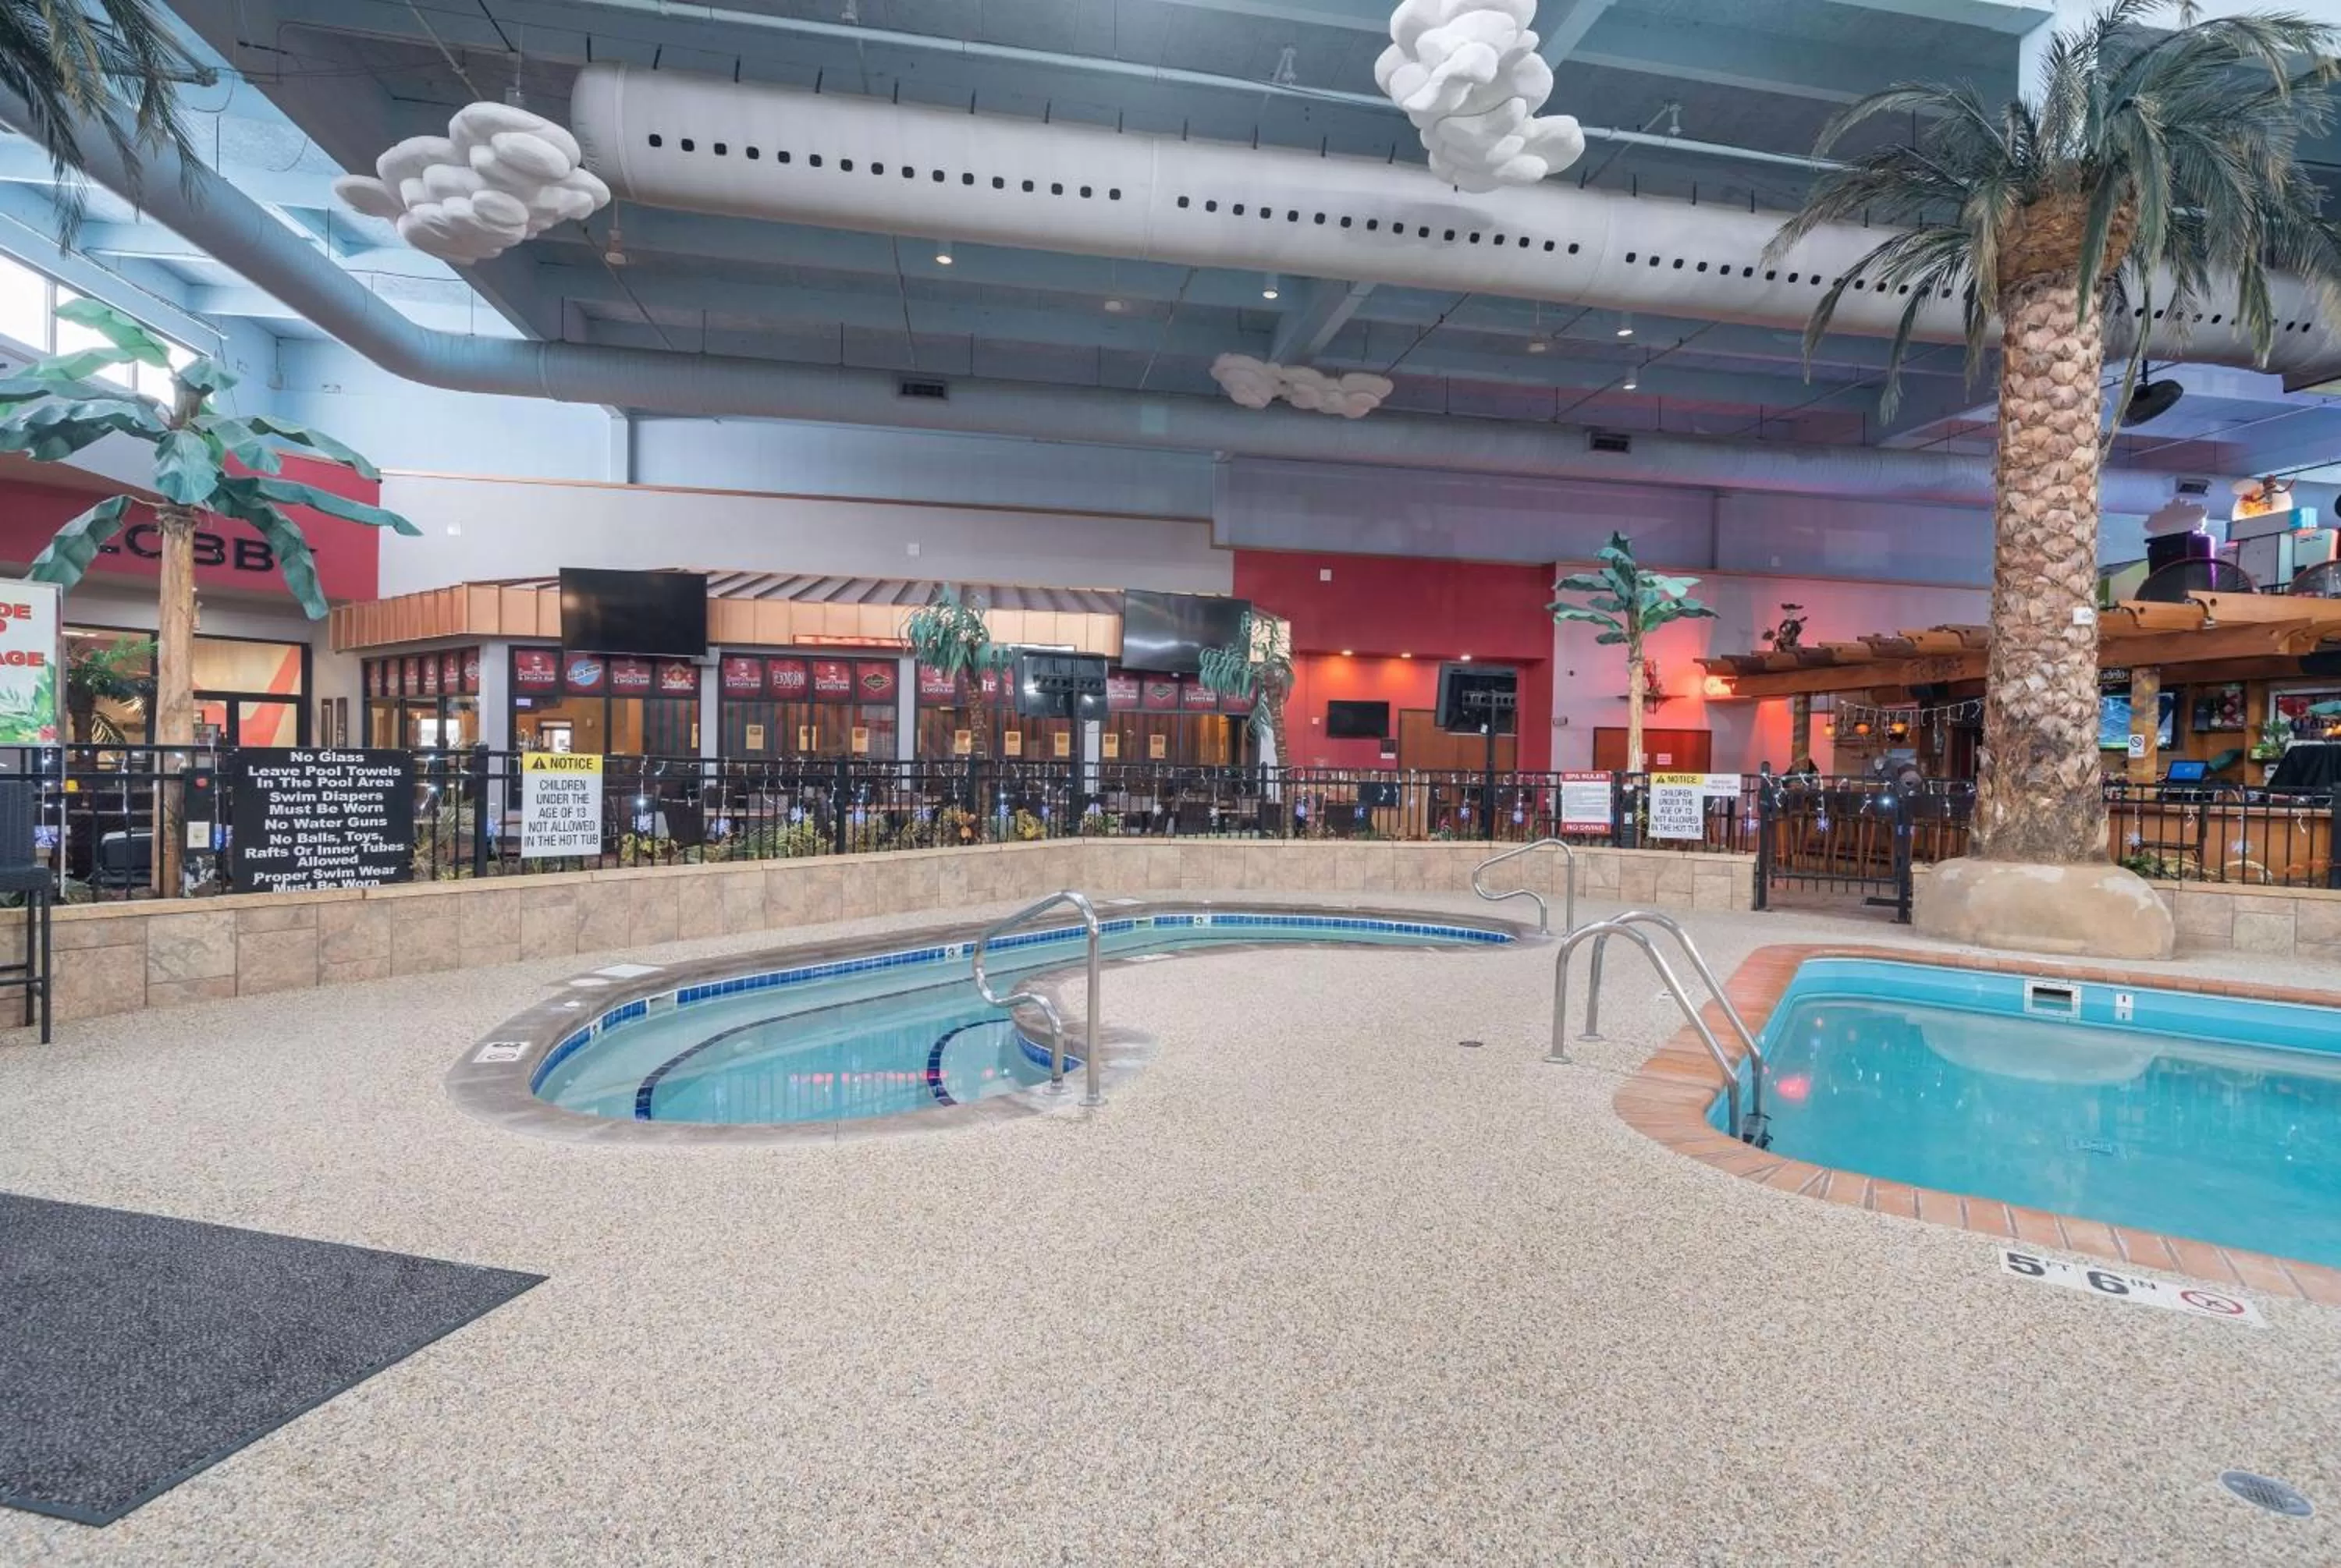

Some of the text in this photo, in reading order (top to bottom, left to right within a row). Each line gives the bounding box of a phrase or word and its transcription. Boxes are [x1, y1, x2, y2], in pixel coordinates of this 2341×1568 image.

[99, 523, 318, 572] OBB
[290, 751, 364, 762] No Glass
[550, 757, 593, 769] NOTICE
[247, 765, 402, 776] Leave Pool Towels
[257, 777, 394, 789] In The Pool Area
[539, 779, 586, 791] CHILDREN
[269, 791, 384, 803] Swim Diapers
[536, 793, 590, 804] UNDER THE
[269, 804, 384, 815] Must Be Worn
[538, 807, 587, 818] AGE OF 13
[265, 817, 387, 830] No Water Guns
[1668, 815, 1698, 824] ALLOWED
[528, 821, 595, 832] NOT ALLOWED
[269, 831, 384, 845] No Balls, Toys,
[524, 834, 599, 847] IN THE HOT TUB
[245, 843, 405, 859] Rafts Or Inner Tubes
[297, 855, 359, 867] Allowed
[253, 865, 397, 885] Proper Swim Wear
[273, 878, 380, 893] Must Be Worn
[2006, 1251, 2158, 1295] 5 FT 6 IN
